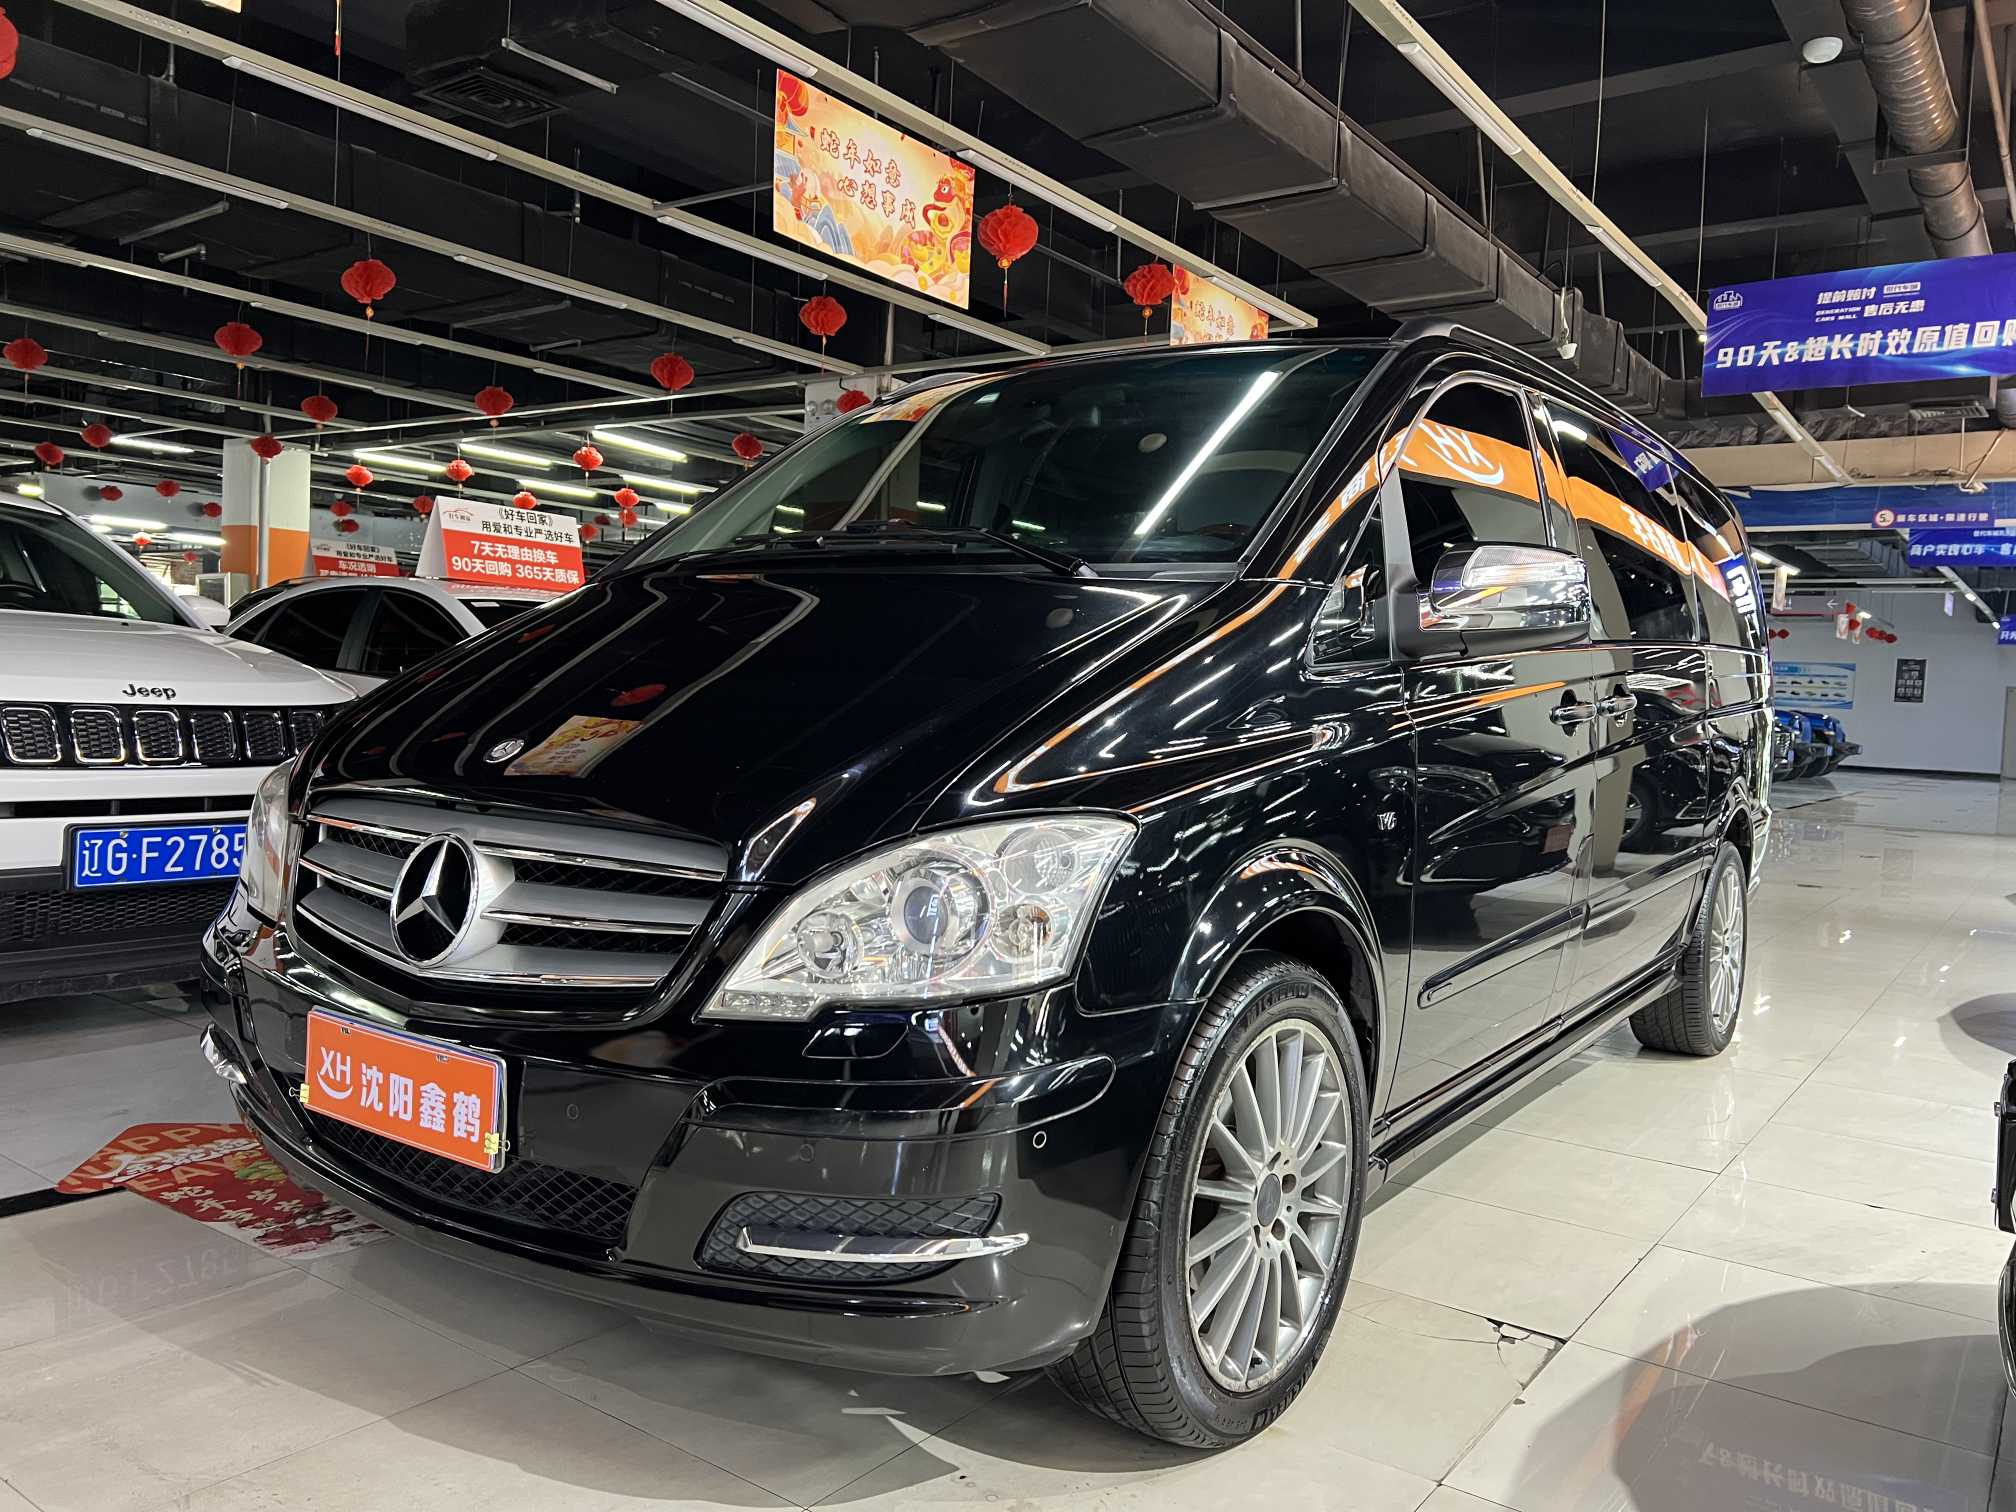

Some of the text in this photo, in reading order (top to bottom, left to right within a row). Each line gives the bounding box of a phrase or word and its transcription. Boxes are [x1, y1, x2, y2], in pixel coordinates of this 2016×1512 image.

[819, 127, 901, 188] 蛇年如意
[837, 175, 917, 230] 心想事成
[481, 520, 576, 544] 用爱和专业严选好车
[499, 508, 554, 527] 《好车回家》
[470, 540, 560, 566] 7天无理由换车
[451, 556, 581, 585] 90天回购 365天质保
[121, 683, 177, 701] Jeep
[81, 832, 246, 877] 辽G·F2785
[359, 1062, 481, 1143] 沈阳鑫鹤
